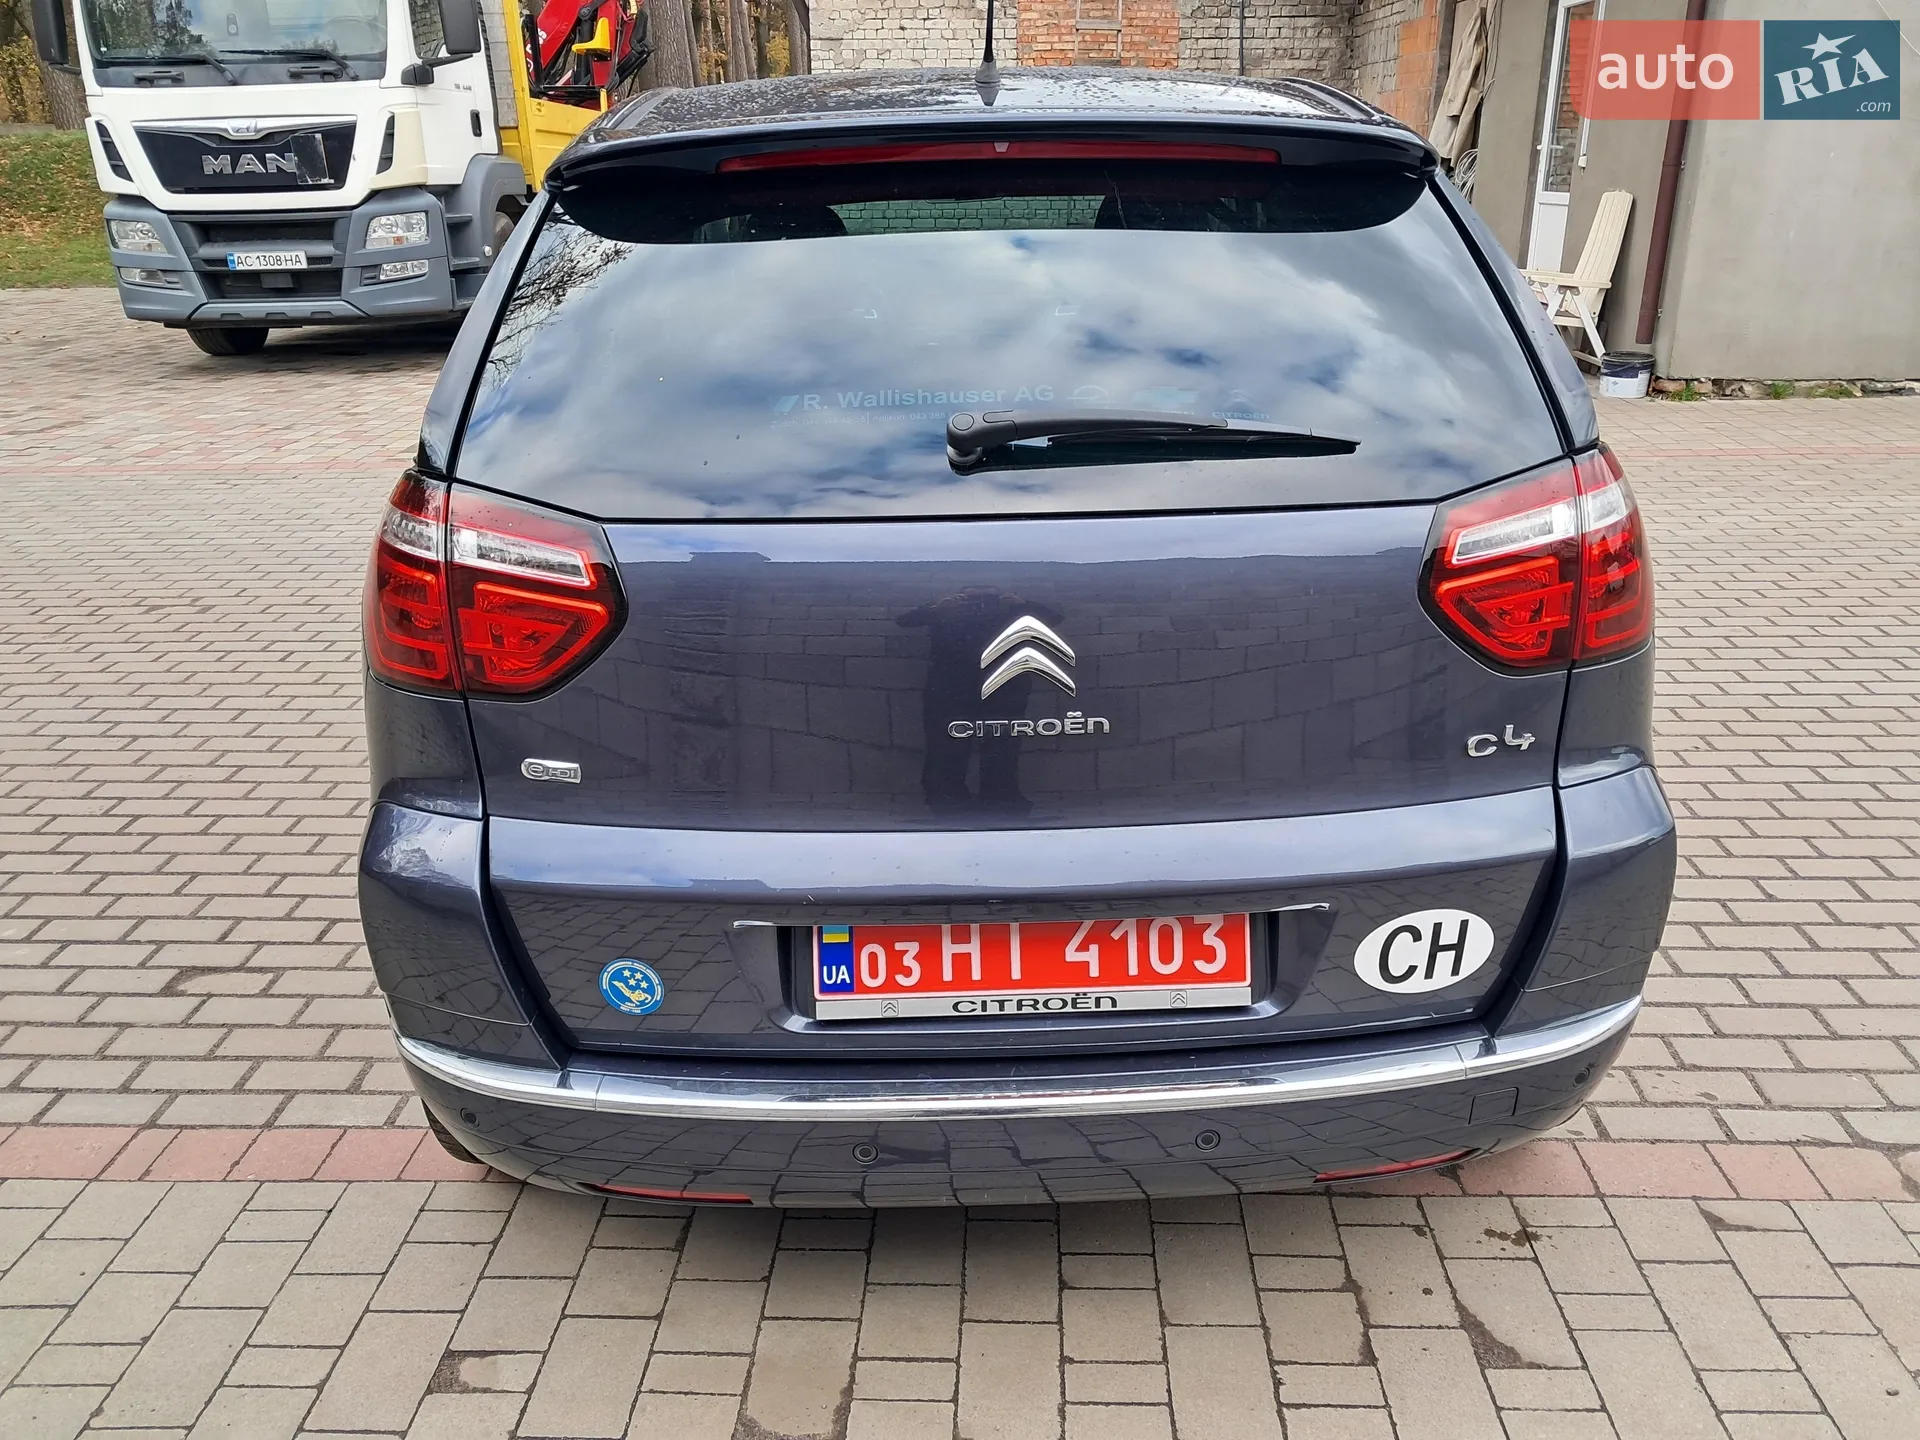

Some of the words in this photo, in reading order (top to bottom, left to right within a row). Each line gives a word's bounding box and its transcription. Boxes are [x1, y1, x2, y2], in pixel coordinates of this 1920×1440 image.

[201, 152, 297, 175] MAN
[236, 255, 253, 268] AC
[255, 254, 283, 267] 1308
[284, 254, 303, 267] HA
[803, 393, 829, 411] R.
[836, 388, 1007, 409] Wallishauser
[1014, 384, 1055, 402] AG
[1467, 724, 1536, 757] C4
[860, 942, 922, 988] 03
[1065, 914, 1227, 978] 4103
[1378, 919, 1470, 985] CH
[823, 965, 851, 985] UA
